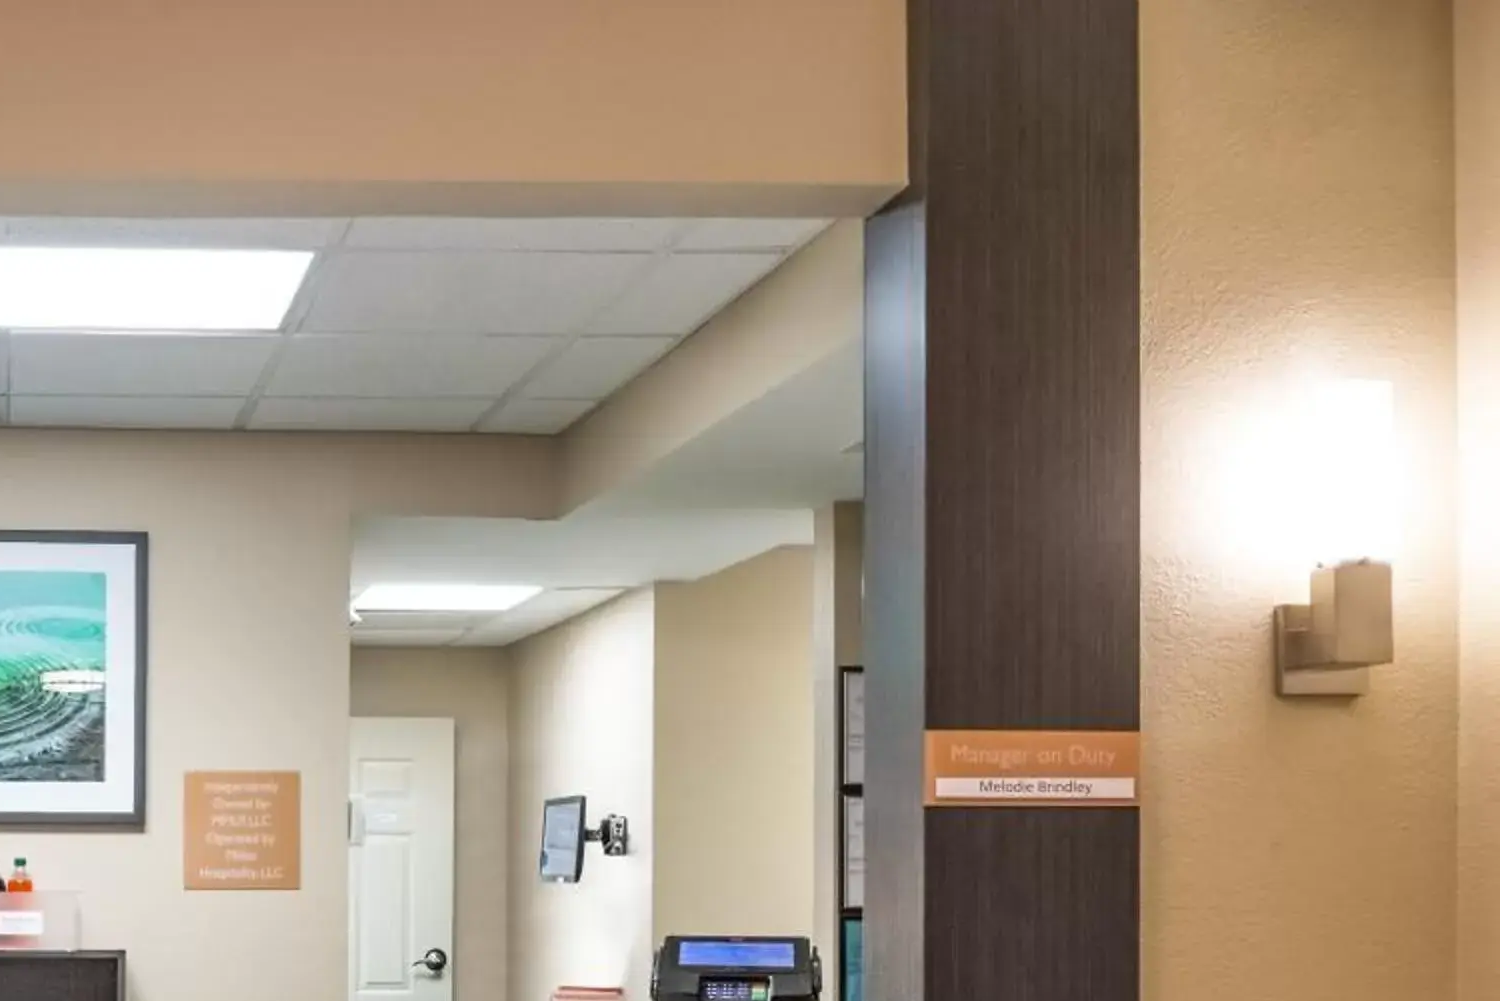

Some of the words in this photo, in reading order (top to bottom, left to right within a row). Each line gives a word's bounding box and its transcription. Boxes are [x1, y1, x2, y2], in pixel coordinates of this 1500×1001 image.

[951, 745, 1029, 770] Manager
[1037, 752, 1062, 765] on
[1068, 745, 1116, 767] Duty
[979, 781, 1035, 793] Melodie
[1037, 781, 1093, 795] Brindley
